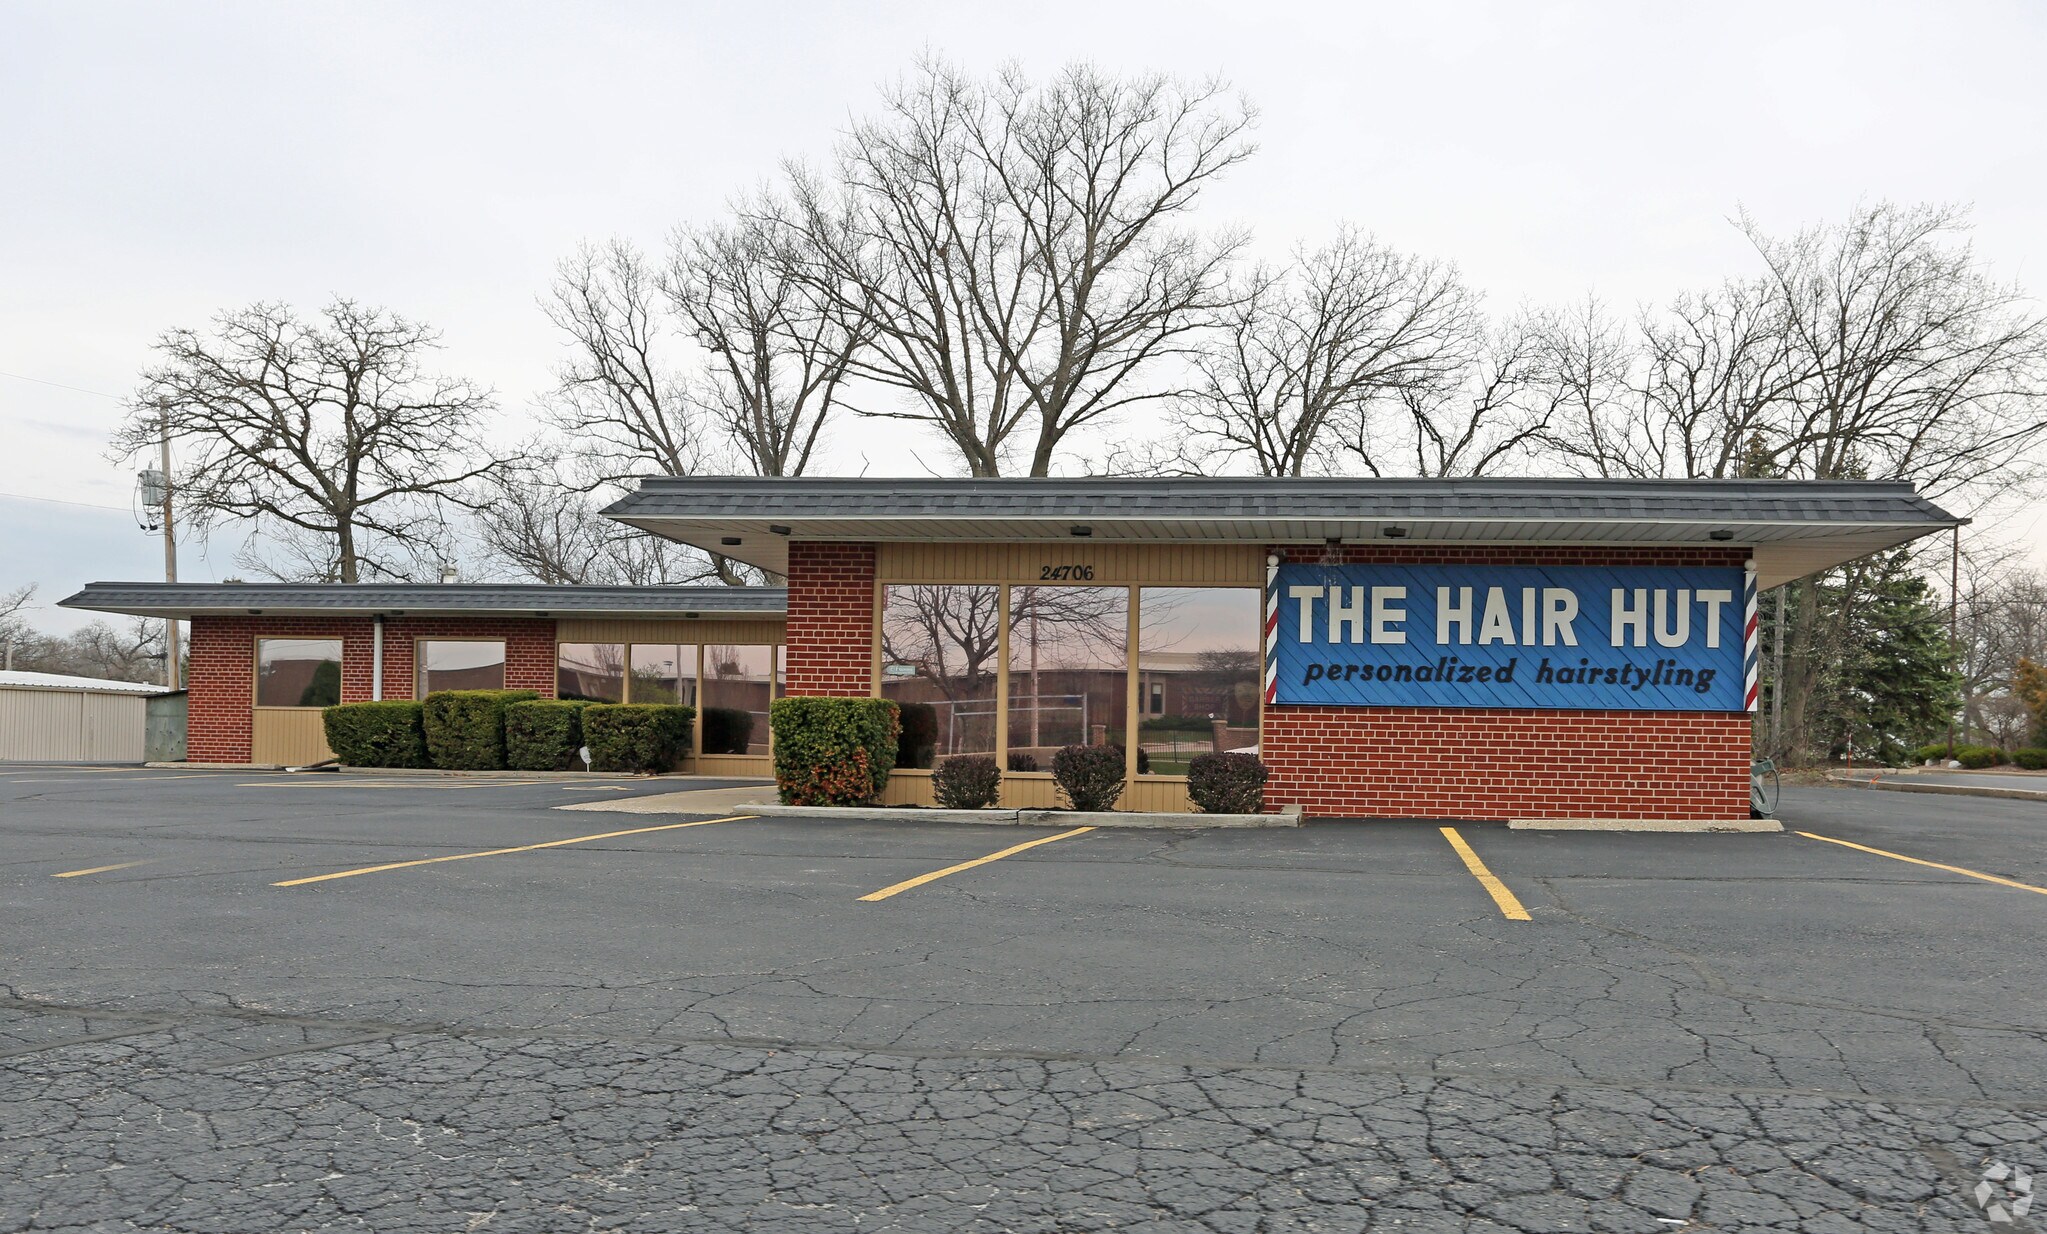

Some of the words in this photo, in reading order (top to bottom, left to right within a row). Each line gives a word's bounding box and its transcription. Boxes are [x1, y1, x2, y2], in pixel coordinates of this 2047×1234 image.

[1040, 565, 1094, 580] 24706
[1289, 586, 1407, 644] THE
[1437, 587, 1579, 646] HAIR
[1611, 588, 1732, 648] HUT
[1304, 656, 1517, 686] personalized
[1536, 658, 1716, 693] hairstyling
